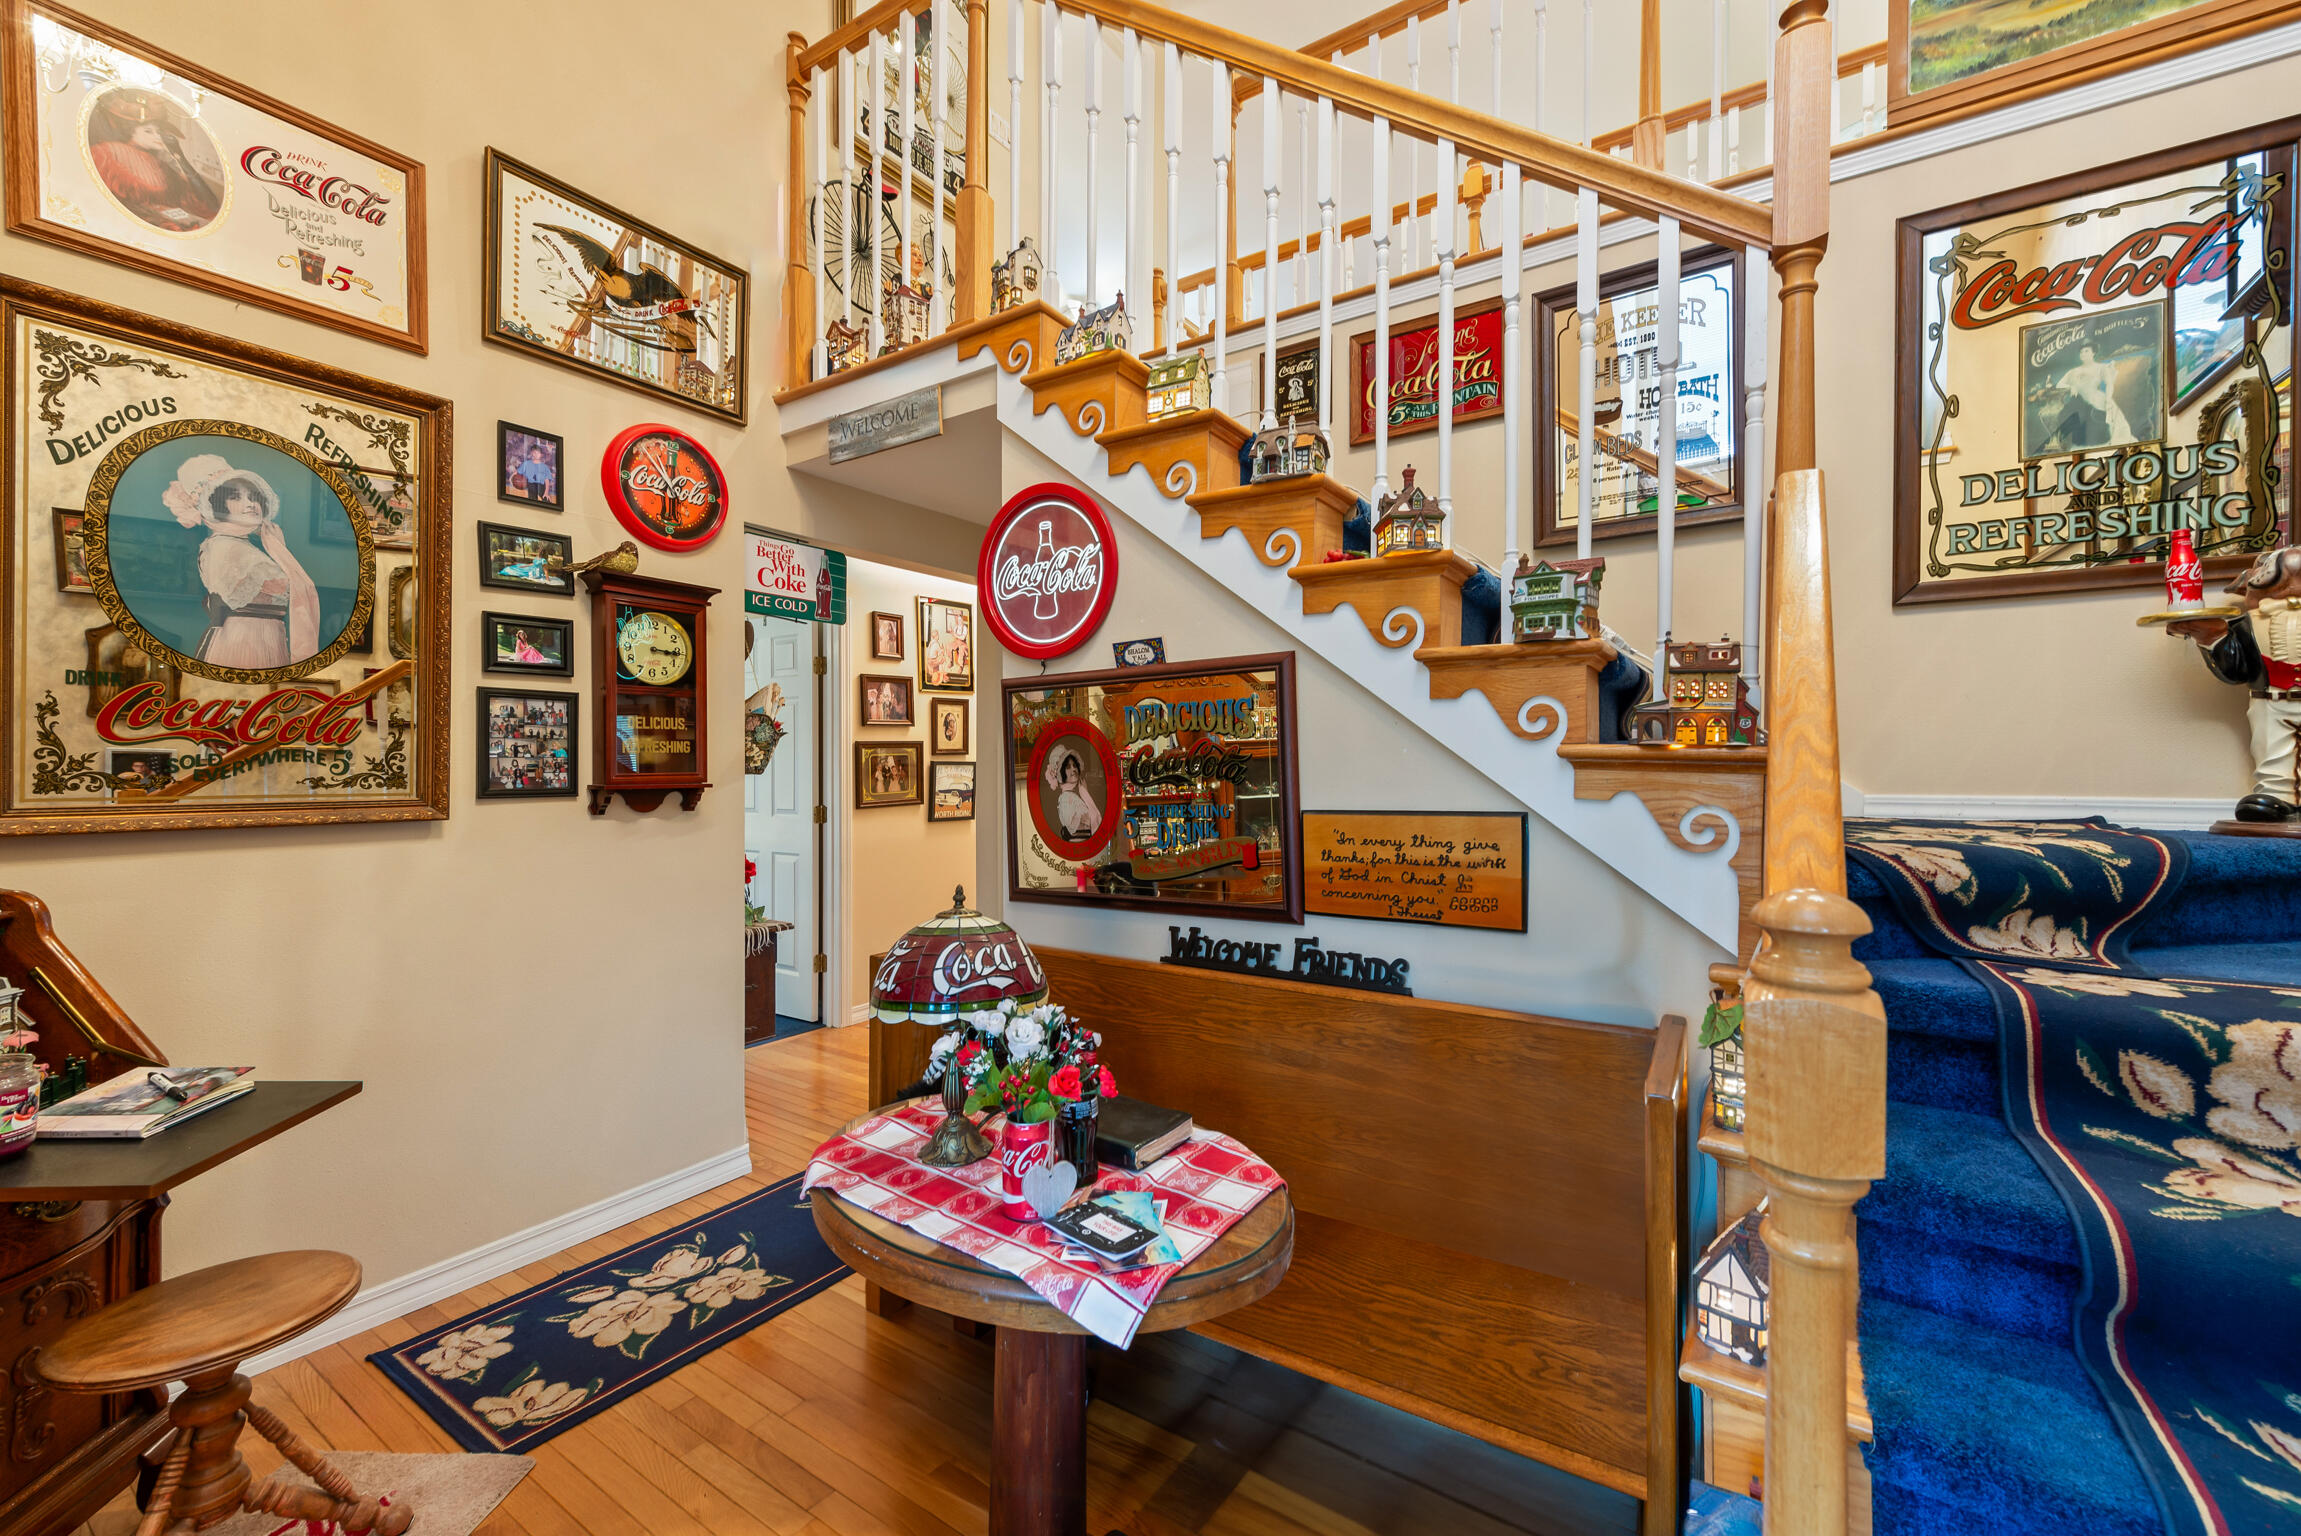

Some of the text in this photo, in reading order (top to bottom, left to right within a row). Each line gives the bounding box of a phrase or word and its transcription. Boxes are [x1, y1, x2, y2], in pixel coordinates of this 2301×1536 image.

[286, 151, 328, 172] DRINK
[240, 145, 391, 227] Coca-Cola
[263, 187, 337, 225] Delicious
[285, 219, 365, 257] Refreshing
[305, 222, 323, 234] and
[1951, 206, 2255, 330] Coca-Cola
[635, 310, 653, 318] DRINK
[1620, 297, 1707, 333] KEEER
[2031, 324, 2085, 368] Coca-Cola
[1279, 359, 1314, 378] Coca-Cola
[1366, 347, 1493, 409] Cca-Cla
[1412, 384, 1497, 418] THIS FNTAIN
[1639, 373, 1719, 409] HO BATH
[45, 395, 178, 467] DELICIOUS
[840, 402, 919, 440] WELCOME
[1565, 430, 1643, 464] CLN BEDS
[303, 422, 406, 527] REFRESHING
[628, 464, 709, 505] CocaCola
[1959, 439, 2240, 507] DELICIOUS
[2065, 489, 2124, 510] AND
[1945, 490, 2256, 556] REFRESHING
[756, 545, 794, 563] Better
[759, 540, 795, 555] Things Go
[757, 567, 807, 593] Coke
[771, 559, 805, 577] With
[997, 543, 1101, 600] Coca-Cola
[752, 594, 808, 612] ICE COLD
[1128, 647, 1150, 655] SHALOM
[65, 669, 124, 687] DRINK
[96, 681, 373, 746] Coca-Cola
[1123, 694, 1258, 745] DELICIOUS
[166, 753, 223, 774] SOLD
[193, 749, 328, 782] EVERYWHERE
[1129, 737, 1252, 788] Coca-Cola
[1160, 790, 1214, 800] The most
[1123, 808, 1139, 839] 5
[1148, 804, 1231, 819] REFRESHING
[1156, 821, 1220, 849] DRINK
[1360, 838, 1405, 851] every
[1410, 834, 1456, 853] thing
[1463, 838, 1500, 855] give
[1176, 841, 1241, 872] WORLD
[1395, 853, 1420, 867] this
[1423, 855, 1435, 867] is
[1437, 854, 1461, 868] the
[1321, 867, 1334, 884] of
[1339, 868, 1370, 882] God
[1375, 872, 1393, 883] in
[1401, 871, 1446, 887] Christ
[1321, 888, 1402, 906] concerning
[1291, 936, 1410, 988] FRIENDS
